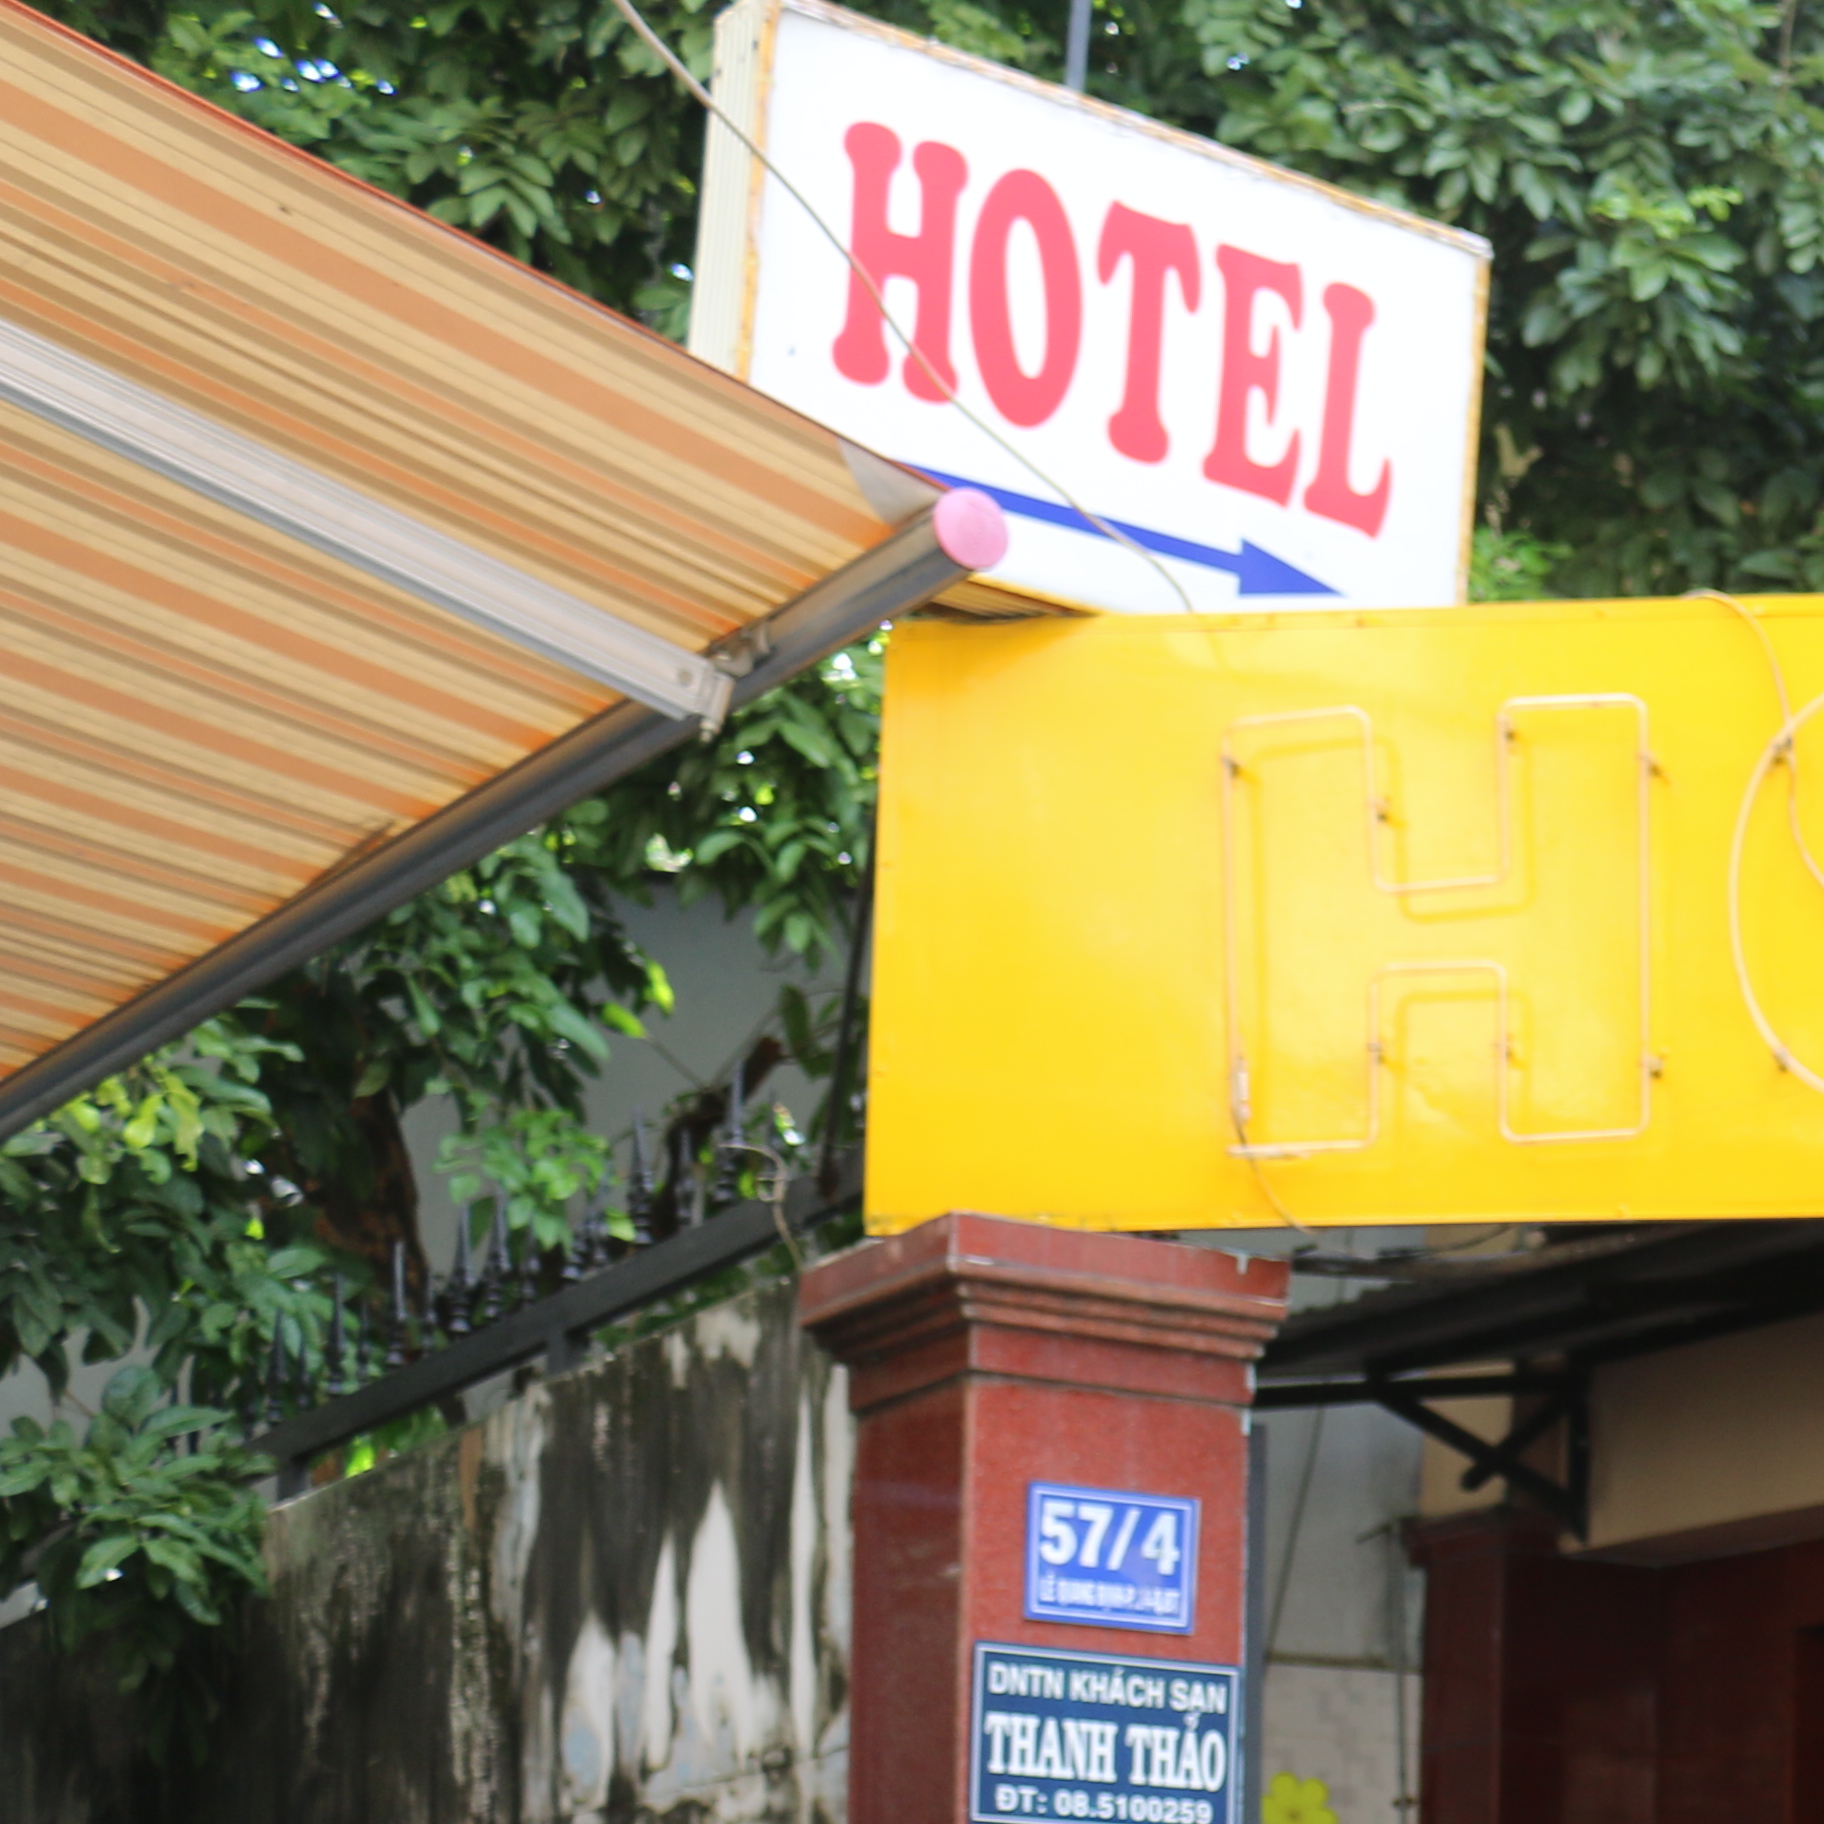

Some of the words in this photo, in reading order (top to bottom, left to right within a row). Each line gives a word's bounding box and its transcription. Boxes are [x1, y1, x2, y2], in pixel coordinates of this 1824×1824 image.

[831, 121, 1392, 539] HOTEL
[1039, 1499, 1181, 1576] 57/4
[989, 1661, 1064, 1700] DNTN
[1069, 1666, 1164, 1708] KHÁCH
[984, 1711, 1118, 1784] THANH
[1125, 1713, 1226, 1792] THẢO
[995, 1784, 1047, 1814] ĐT:
